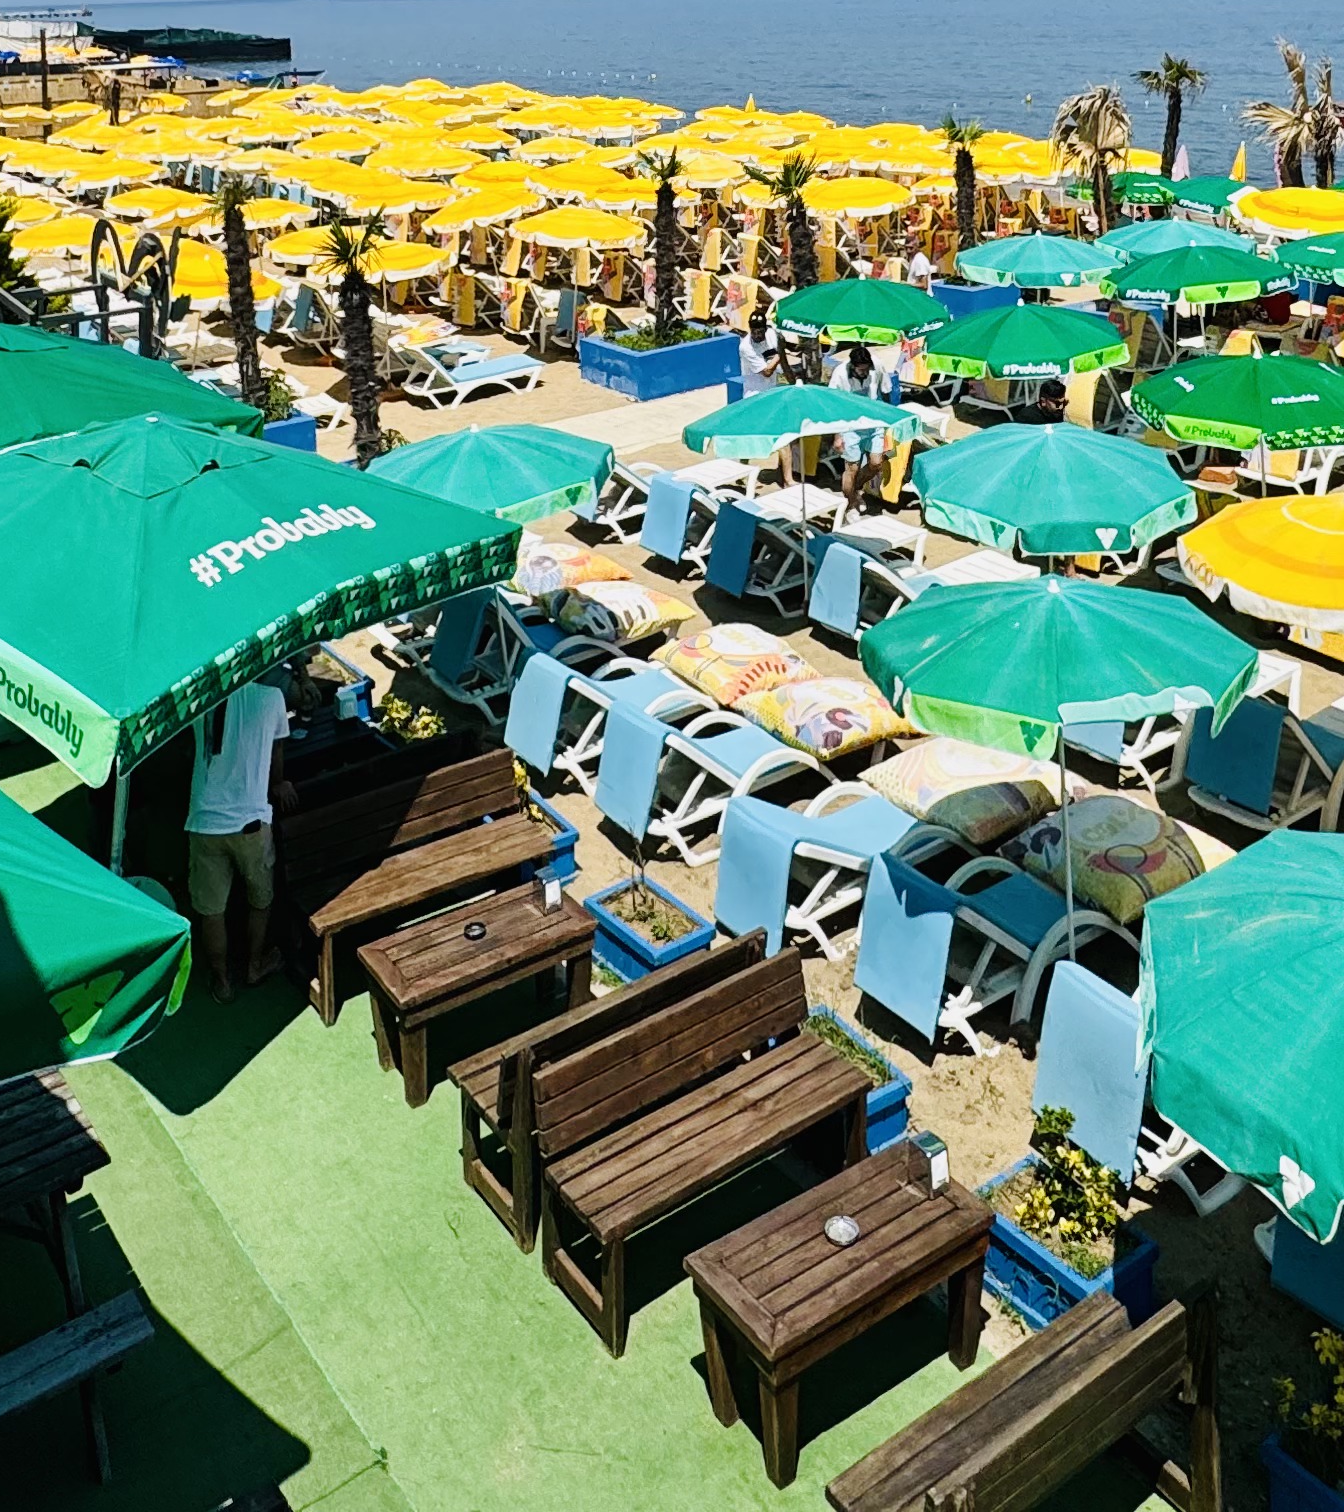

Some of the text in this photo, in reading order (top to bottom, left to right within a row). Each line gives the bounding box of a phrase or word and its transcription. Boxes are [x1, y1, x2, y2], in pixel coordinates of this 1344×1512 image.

[1003, 363, 1060, 377] #Probably
[1184, 425, 1236, 441] #Probably
[191, 502, 376, 587] #Probably
